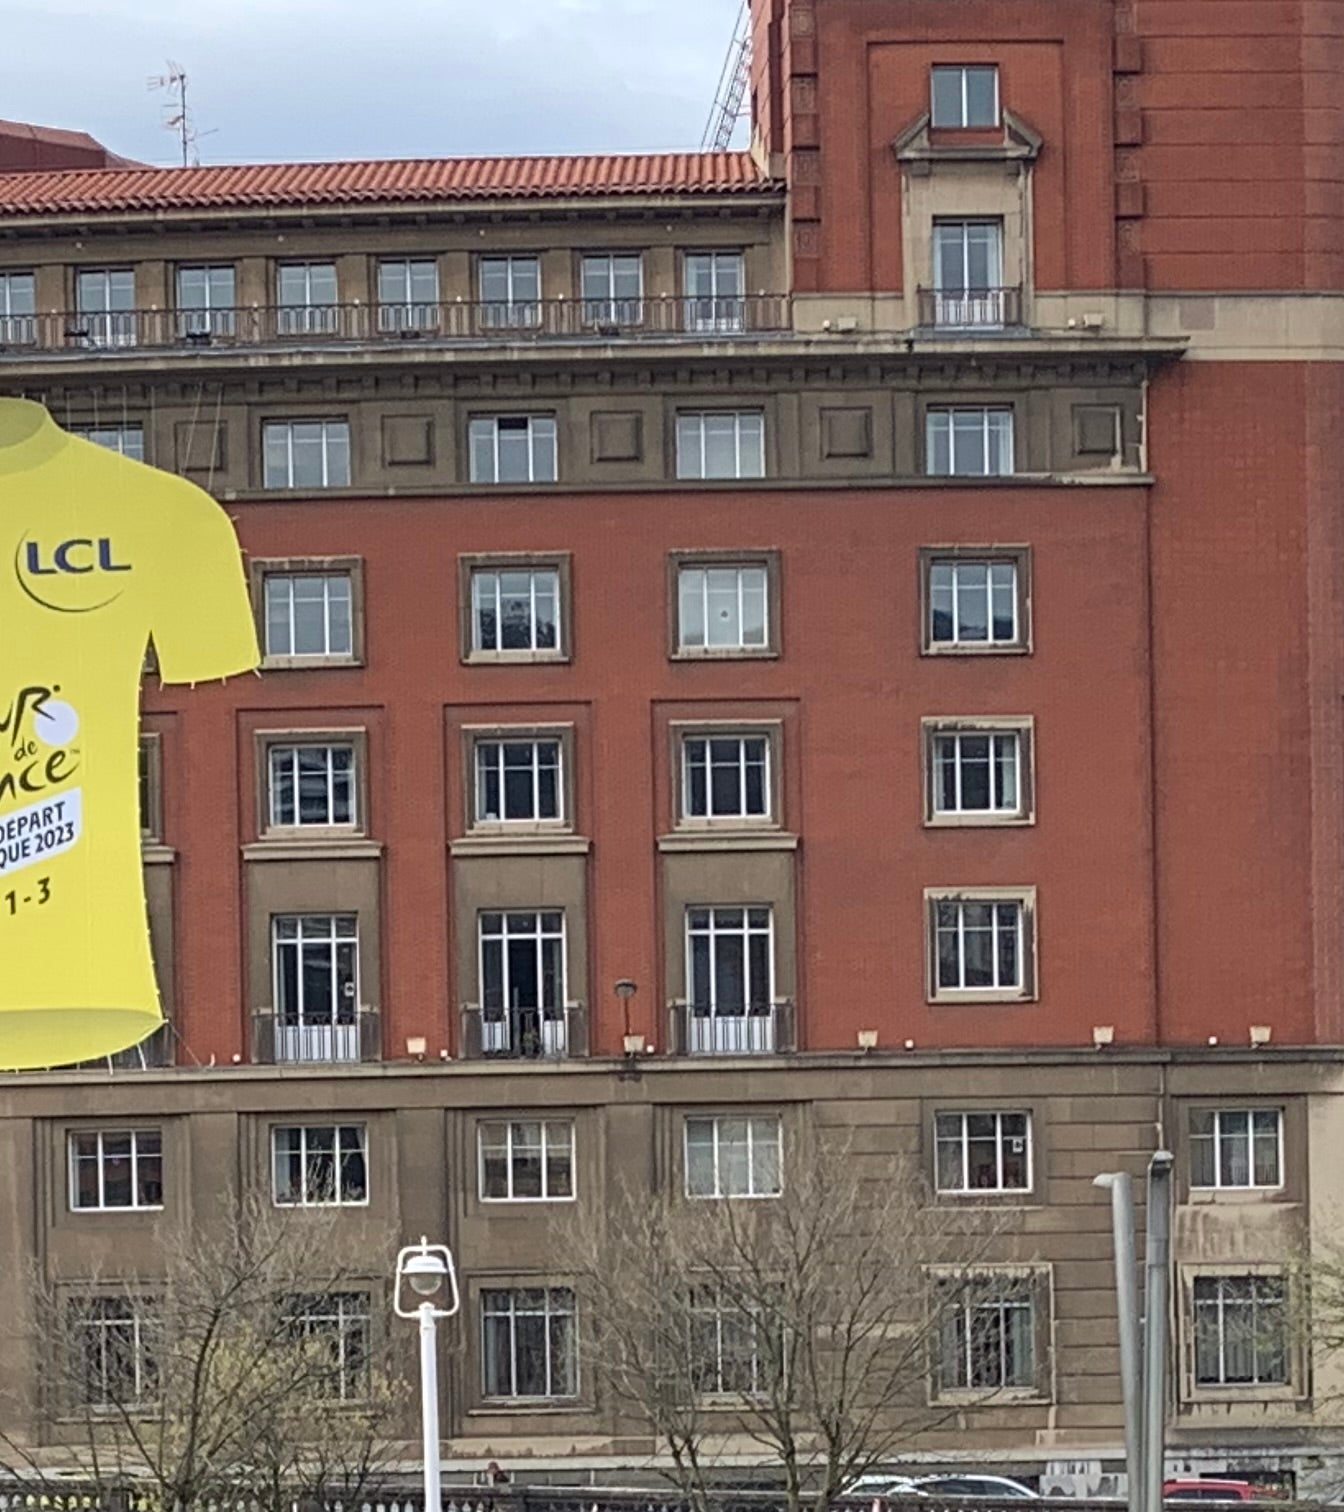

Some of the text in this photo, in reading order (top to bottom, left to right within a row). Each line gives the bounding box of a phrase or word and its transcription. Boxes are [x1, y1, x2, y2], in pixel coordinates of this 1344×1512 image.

[26, 537, 132, 574] LCL
[14, 736, 39, 761] de
[34, 821, 74, 853] 2023
[4, 889, 16, 915] 1
[37, 876, 51, 905] 3
